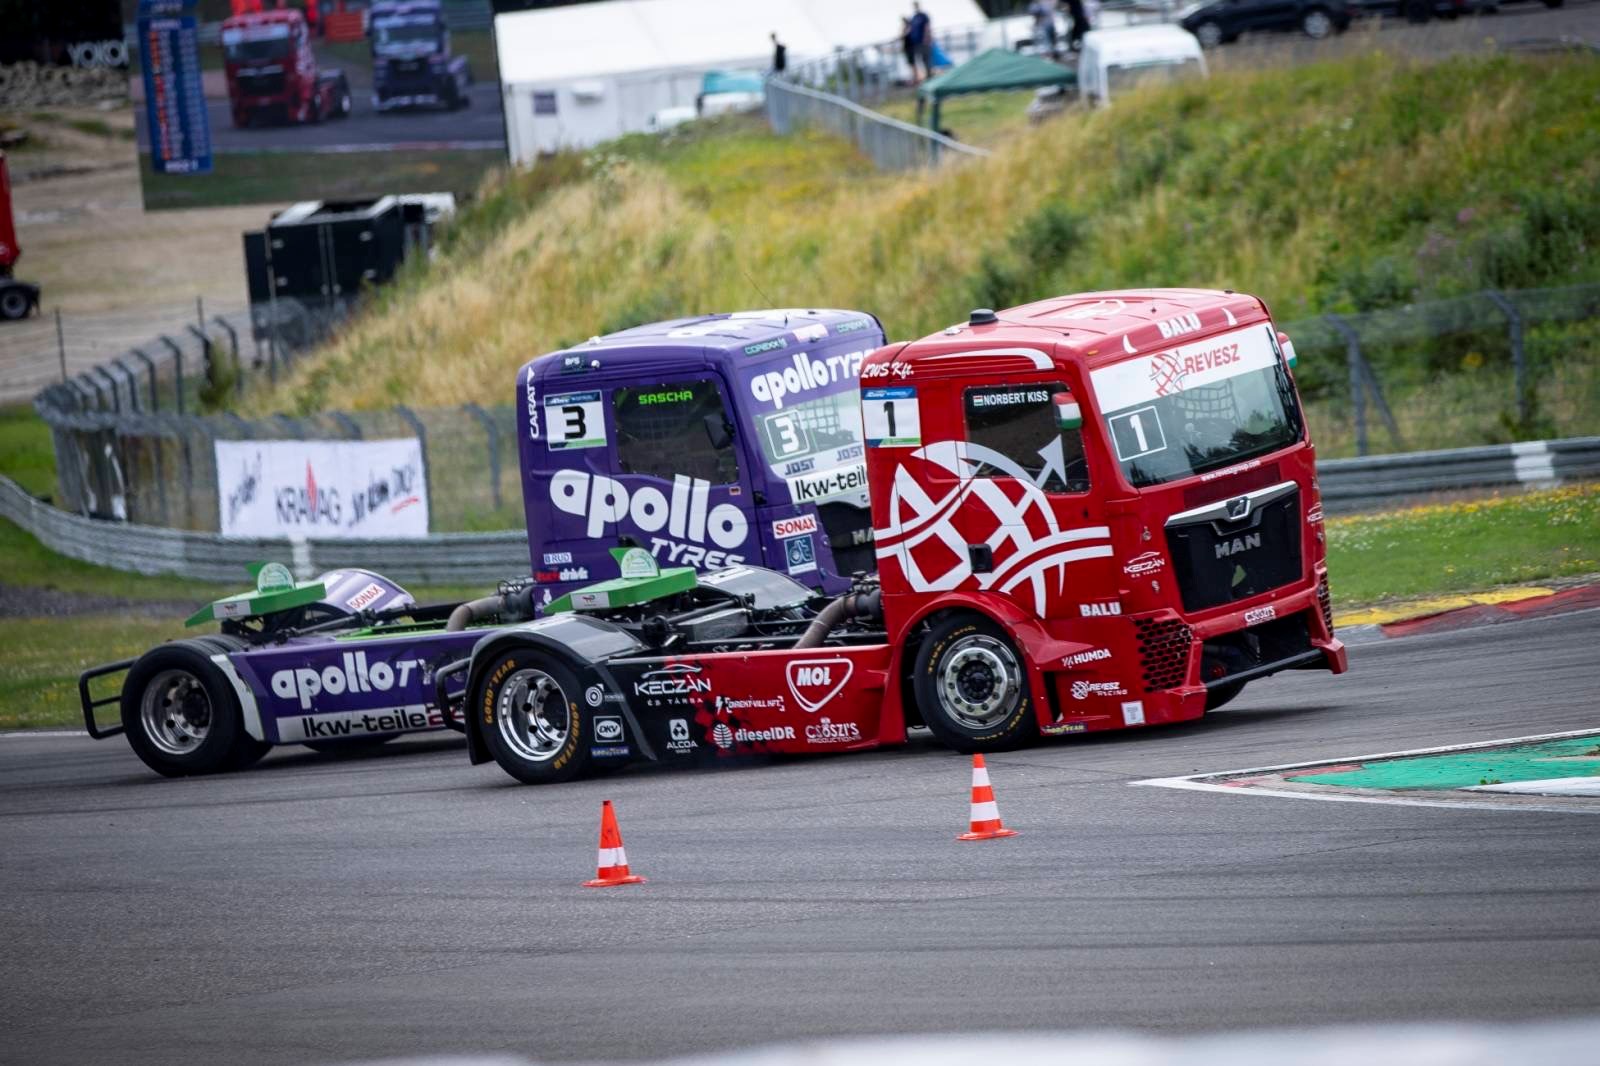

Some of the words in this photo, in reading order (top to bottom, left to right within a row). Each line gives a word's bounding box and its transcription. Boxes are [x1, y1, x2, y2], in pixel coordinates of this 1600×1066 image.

[67, 39, 129, 69] YOKO
[1157, 313, 1202, 339] BALU
[1184, 344, 1241, 375] REVESZ
[638, 390, 693, 405] SASCHA
[983, 392, 1026, 406] NORBERT
[1028, 390, 1049, 402] KISS
[527, 384, 540, 439] CARAT
[562, 405, 587, 440] 3
[882, 401, 896, 437] 1
[775, 416, 800, 453] 3
[1129, 414, 1148, 451] 1
[836, 445, 865, 462] JOST
[785, 458, 816, 476] JOST
[795, 466, 866, 500] lkw-teil
[549, 468, 749, 549] apollo
[775, 518, 816, 536] SONAX
[852, 526, 874, 545] MA
[650, 537, 745, 571] TYRES
[1215, 532, 1262, 559] MAN
[350, 585, 382, 609] SONAX
[1079, 601, 1122, 617] BALU
[1073, 649, 1112, 664] HUMDA
[797, 667, 832, 686] MOL
[599, 725, 618, 734] DKV
[735, 727, 796, 742] dieselDR
[666, 740, 699, 749] ALCOA
